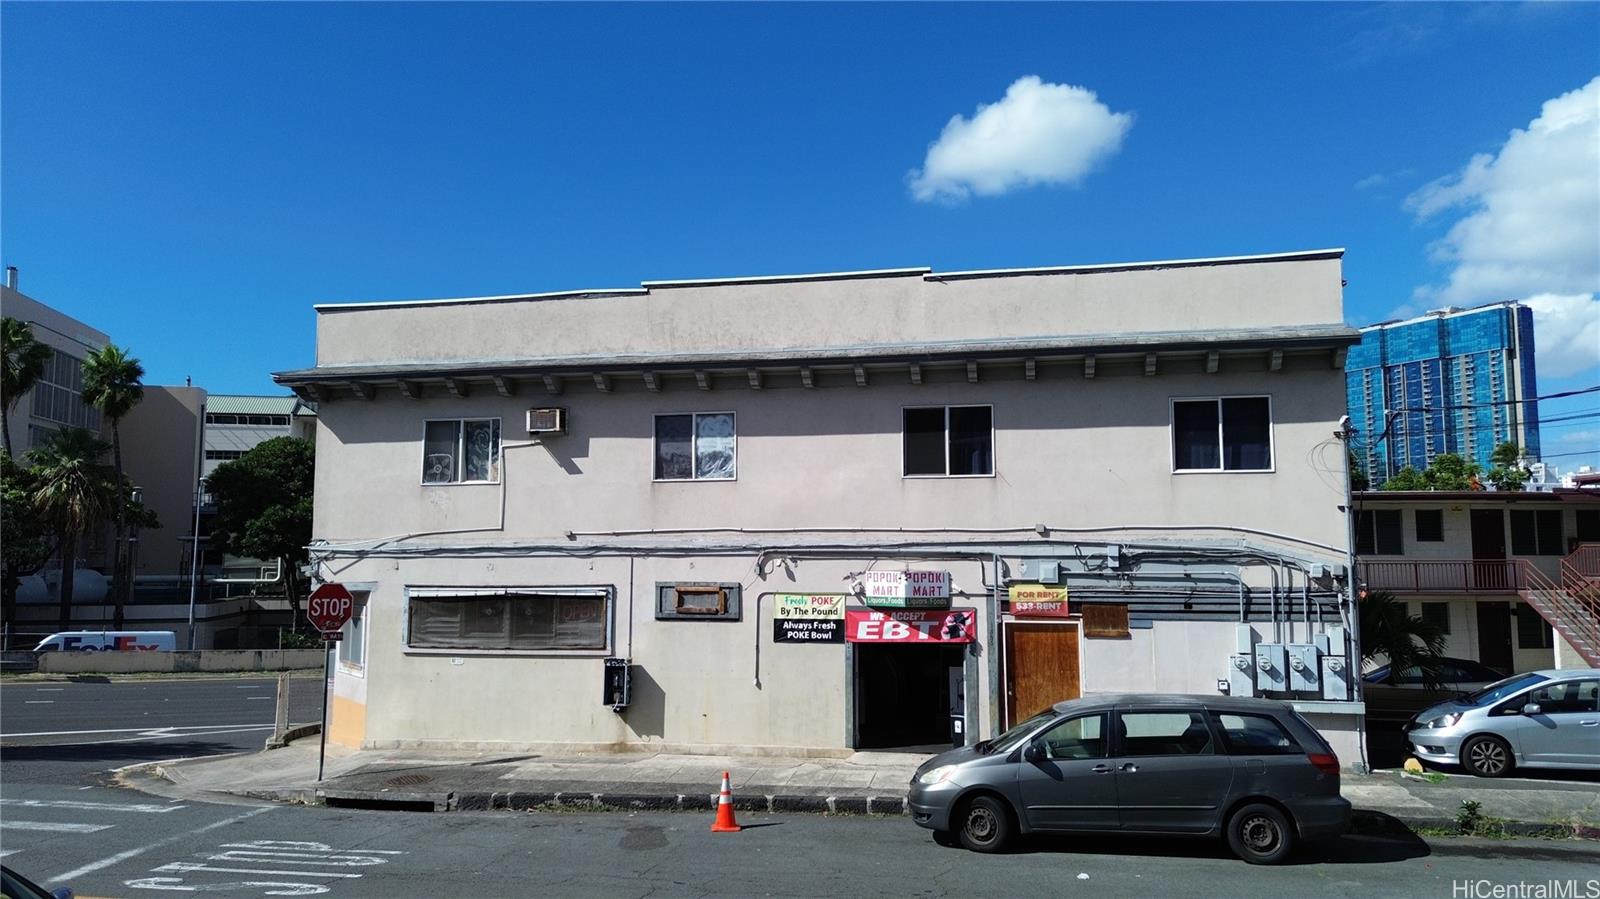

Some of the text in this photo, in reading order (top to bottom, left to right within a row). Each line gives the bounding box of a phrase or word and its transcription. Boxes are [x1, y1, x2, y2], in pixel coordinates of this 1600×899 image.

[867, 573, 900, 583] POPOK
[905, 572, 945, 583] POPOKI
[873, 586, 900, 596] MART
[912, 586, 943, 596] MART
[783, 595, 834, 605] Fresh POKE
[311, 598, 351, 617] STOP
[1016, 602, 1061, 610] 533-RENT
[780, 607, 838, 617] By The Pound
[869, 612, 926, 621] WE ACCEPT
[783, 621, 836, 630] Always Fresh
[857, 621, 939, 640] EBT
[787, 631, 832, 639] POKE Bowl
[63, 637, 159, 651] FdE
